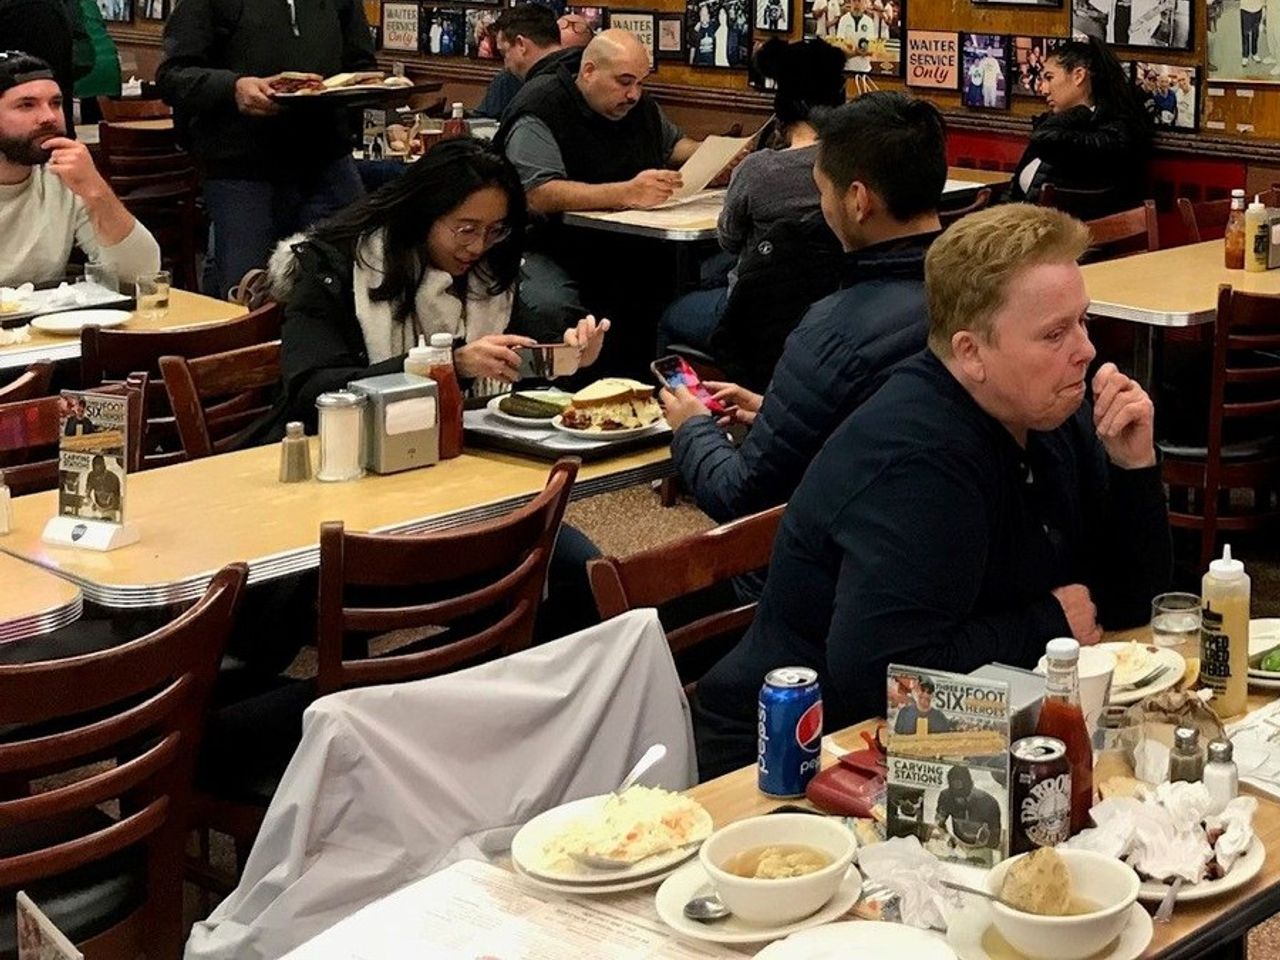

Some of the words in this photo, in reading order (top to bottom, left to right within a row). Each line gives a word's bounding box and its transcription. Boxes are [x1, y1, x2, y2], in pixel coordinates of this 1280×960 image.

[612, 19, 652, 31] WAITER
[909, 39, 956, 52] WAITER
[909, 52, 956, 67] SERVICE
[912, 65, 950, 84] Only
[935, 690, 964, 711] SIX
[965, 687, 1006, 703] FOOT
[758, 700, 770, 775] pepsi
[894, 759, 944, 776] CARVING
[894, 769, 944, 786] STATIONS
